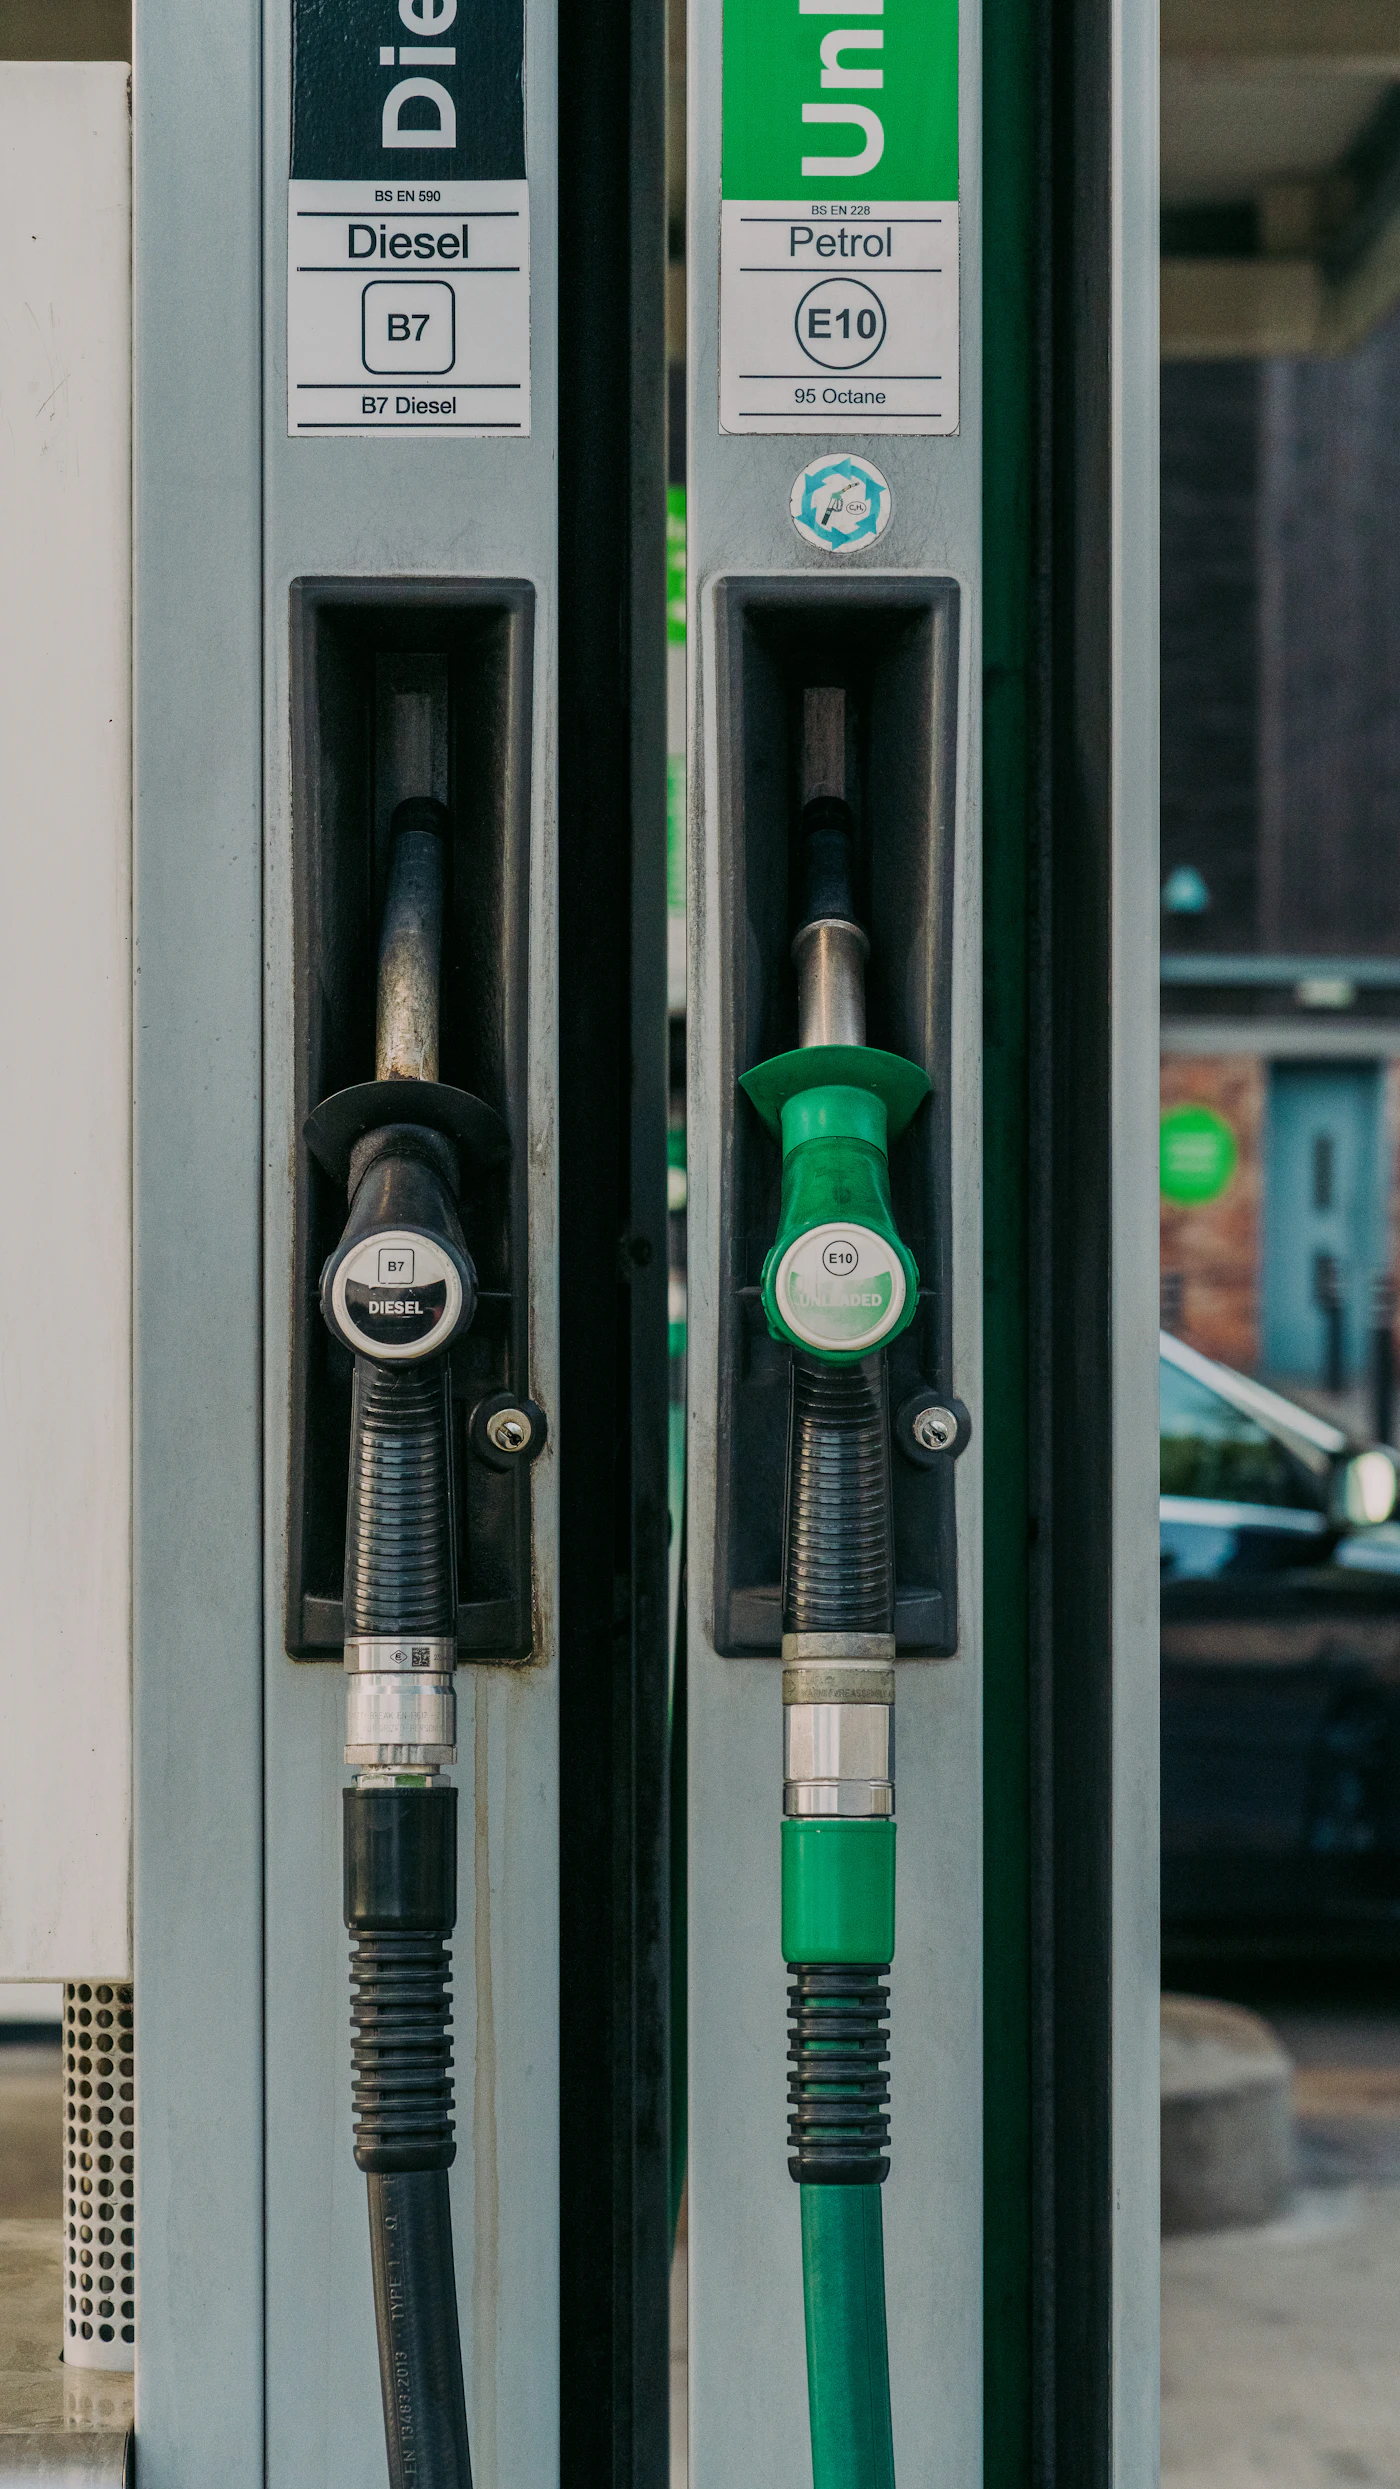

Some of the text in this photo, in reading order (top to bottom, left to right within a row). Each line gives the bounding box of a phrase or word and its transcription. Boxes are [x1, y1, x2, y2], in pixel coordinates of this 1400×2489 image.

[379, 0, 457, 148] Die
[375, 190, 441, 202] BS EN 590
[811, 205, 871, 216] BS EN 228
[347, 224, 469, 259] Diesel
[789, 226, 892, 258] Petrol
[387, 314, 430, 342] B7
[807, 308, 877, 339] E10
[362, 396, 456, 415] B7 Diesel
[794, 388, 886, 405] 95 Octane
[388, 1261, 405, 1272] B7
[829, 1253, 853, 1264] E10
[368, 1301, 424, 1315] DIESEL
[369, 1711, 394, 1720] BREAK
[388, 2277, 405, 2321] TYPE
[404, 2450, 417, 2475] EN
